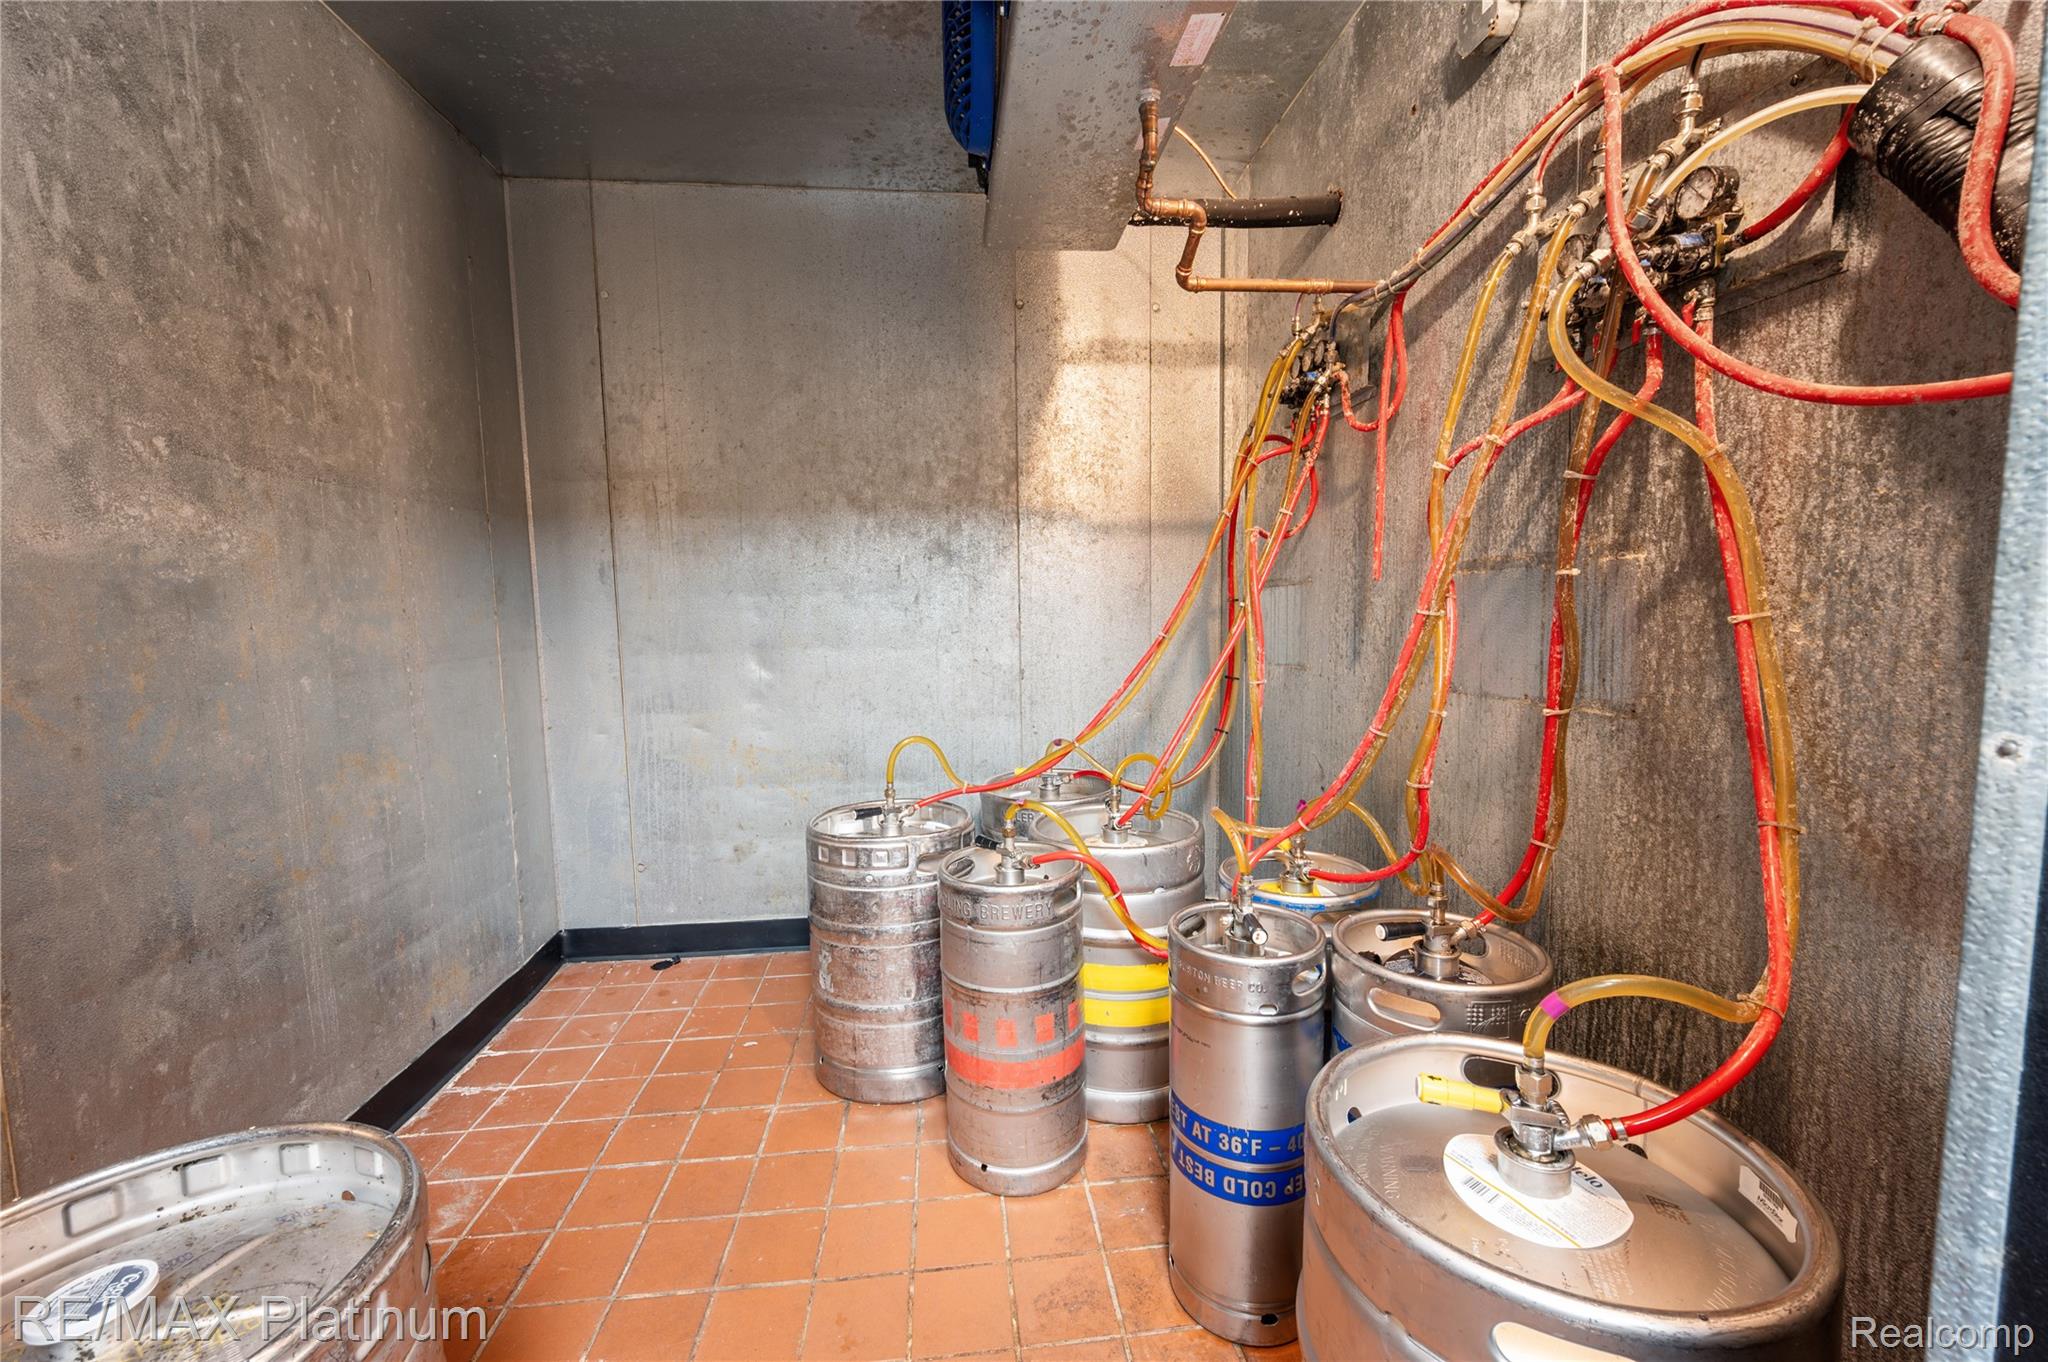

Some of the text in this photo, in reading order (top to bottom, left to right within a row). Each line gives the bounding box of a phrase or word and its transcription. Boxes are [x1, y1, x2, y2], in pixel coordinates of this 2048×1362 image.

[979, 900, 1056, 921] BREWERY
[1191, 1120, 1213, 1144] AT
[1178, 1149, 1215, 1188] BEST
[1222, 1175, 1277, 1199] COLD
